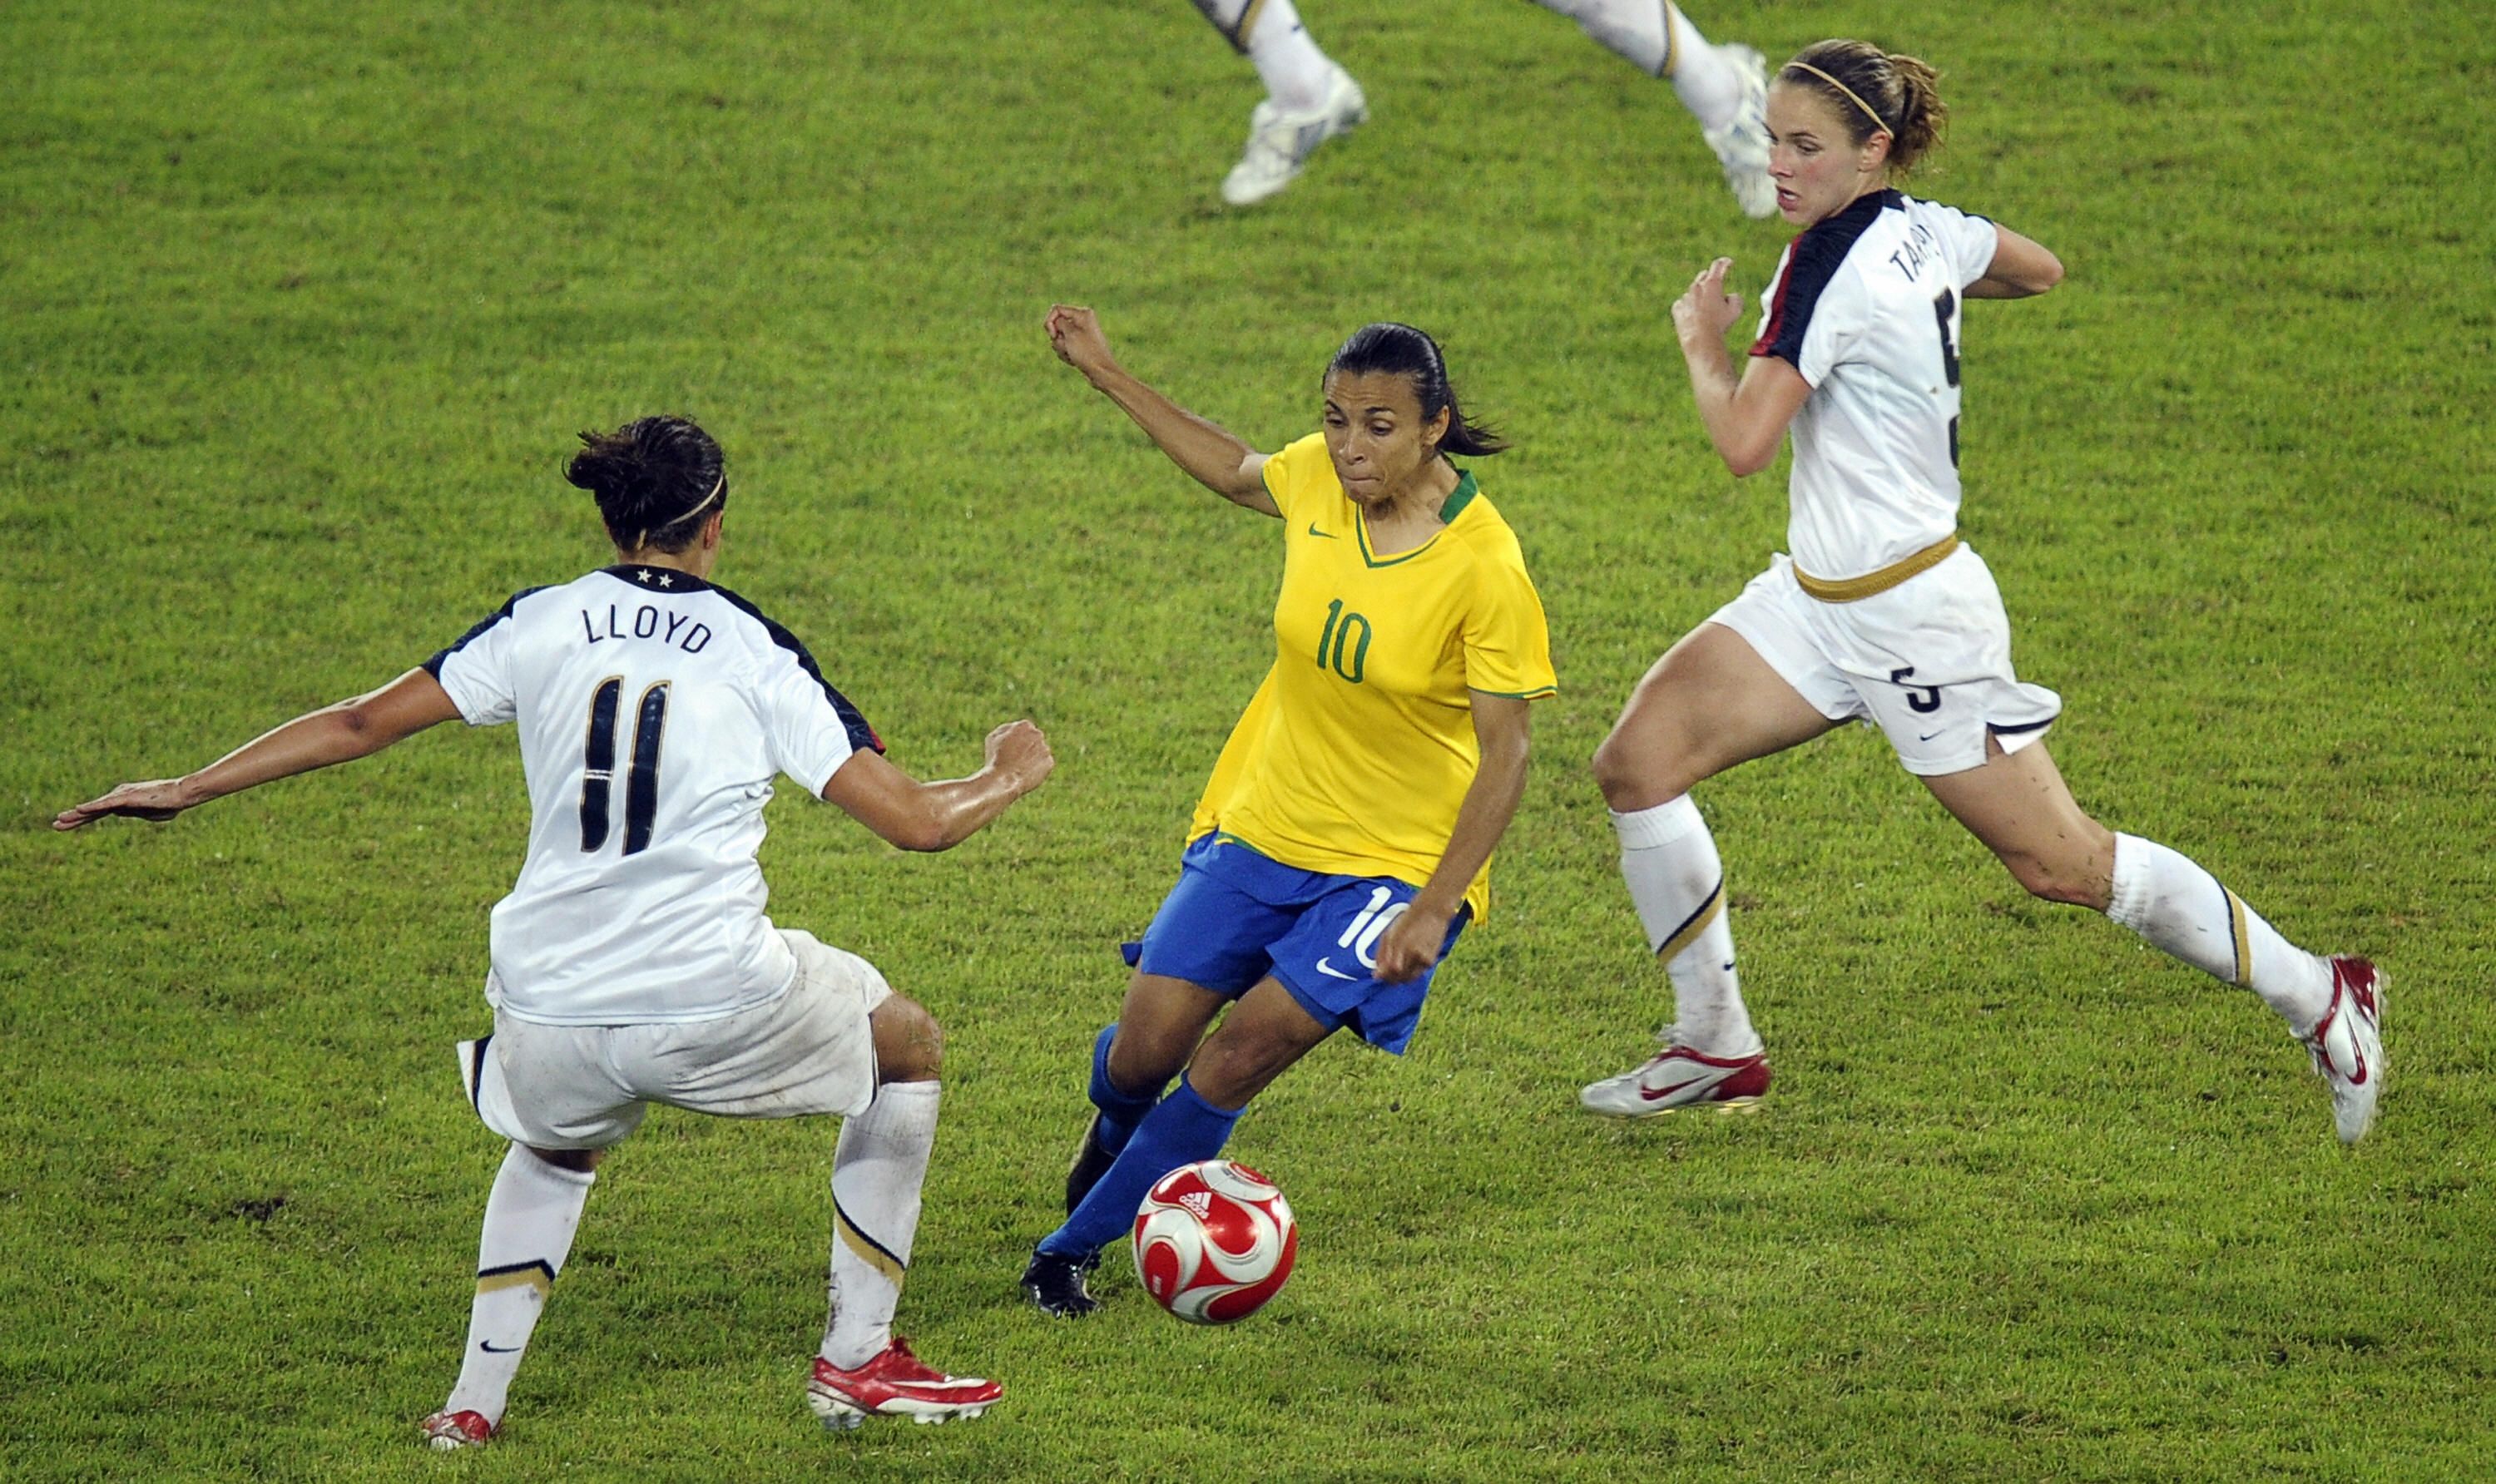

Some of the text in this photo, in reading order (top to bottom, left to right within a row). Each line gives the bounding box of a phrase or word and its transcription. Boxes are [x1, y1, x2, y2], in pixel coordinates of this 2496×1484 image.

[582, 604, 712, 655] LLOYD
[1316, 597, 1372, 684] 10
[1890, 665, 1941, 714] 5
[580, 675, 672, 857] 11
